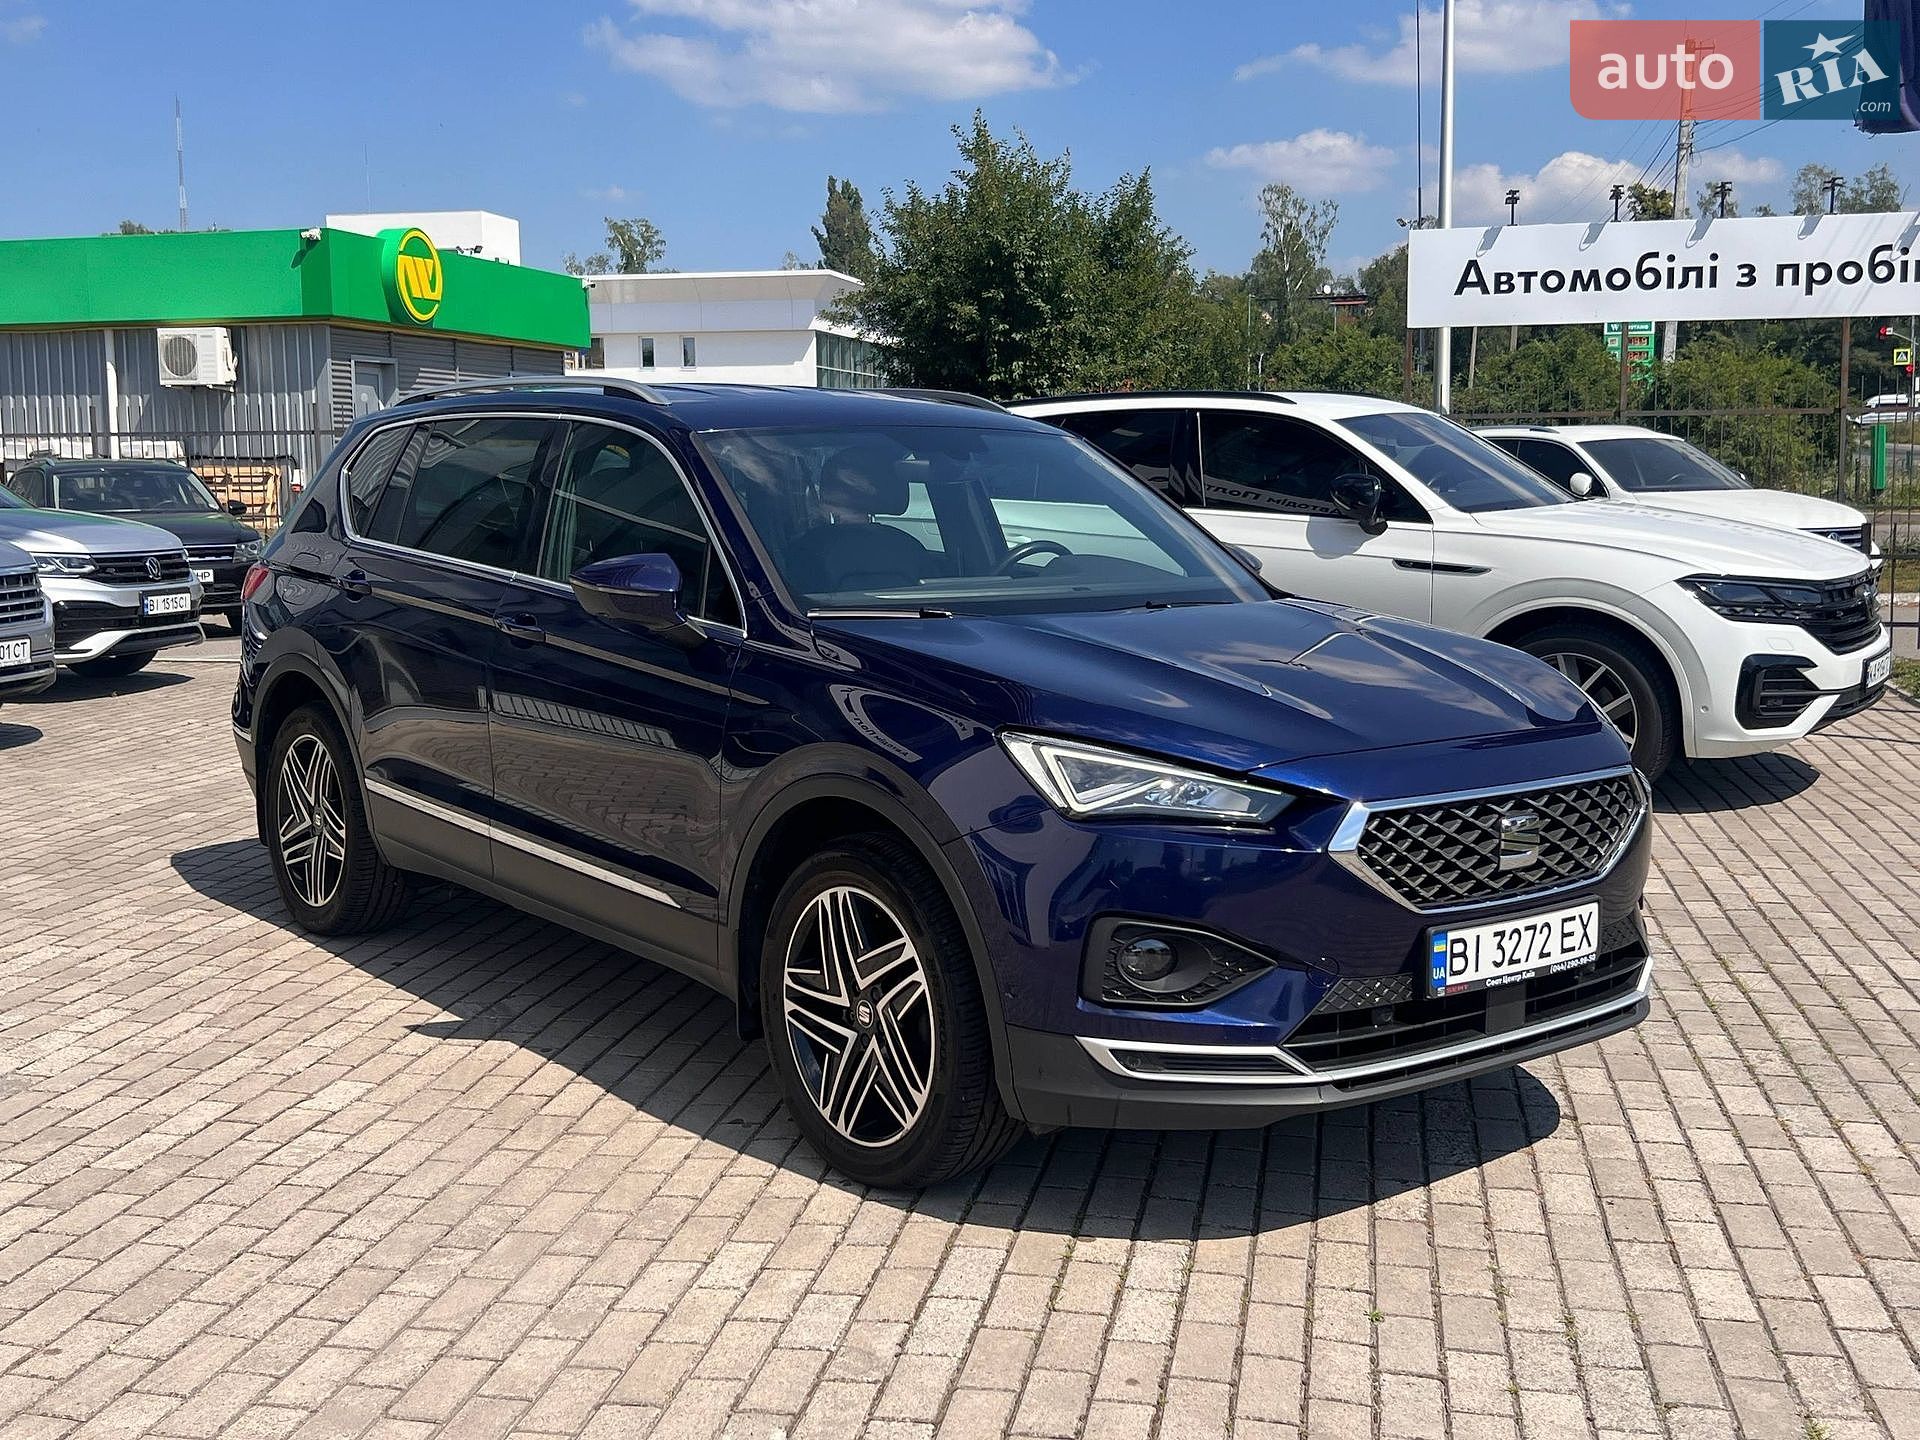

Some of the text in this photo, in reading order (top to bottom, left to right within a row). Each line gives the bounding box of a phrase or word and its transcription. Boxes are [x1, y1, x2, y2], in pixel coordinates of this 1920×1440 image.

[1454, 250, 1719, 297] Автомобілі
[1735, 261, 1757, 288] з
[149, 599, 159, 612] BI
[13, 642, 28, 658] CT
[1449, 911, 1593, 976] BI 3272 EX
[1432, 968, 1446, 980] UA
